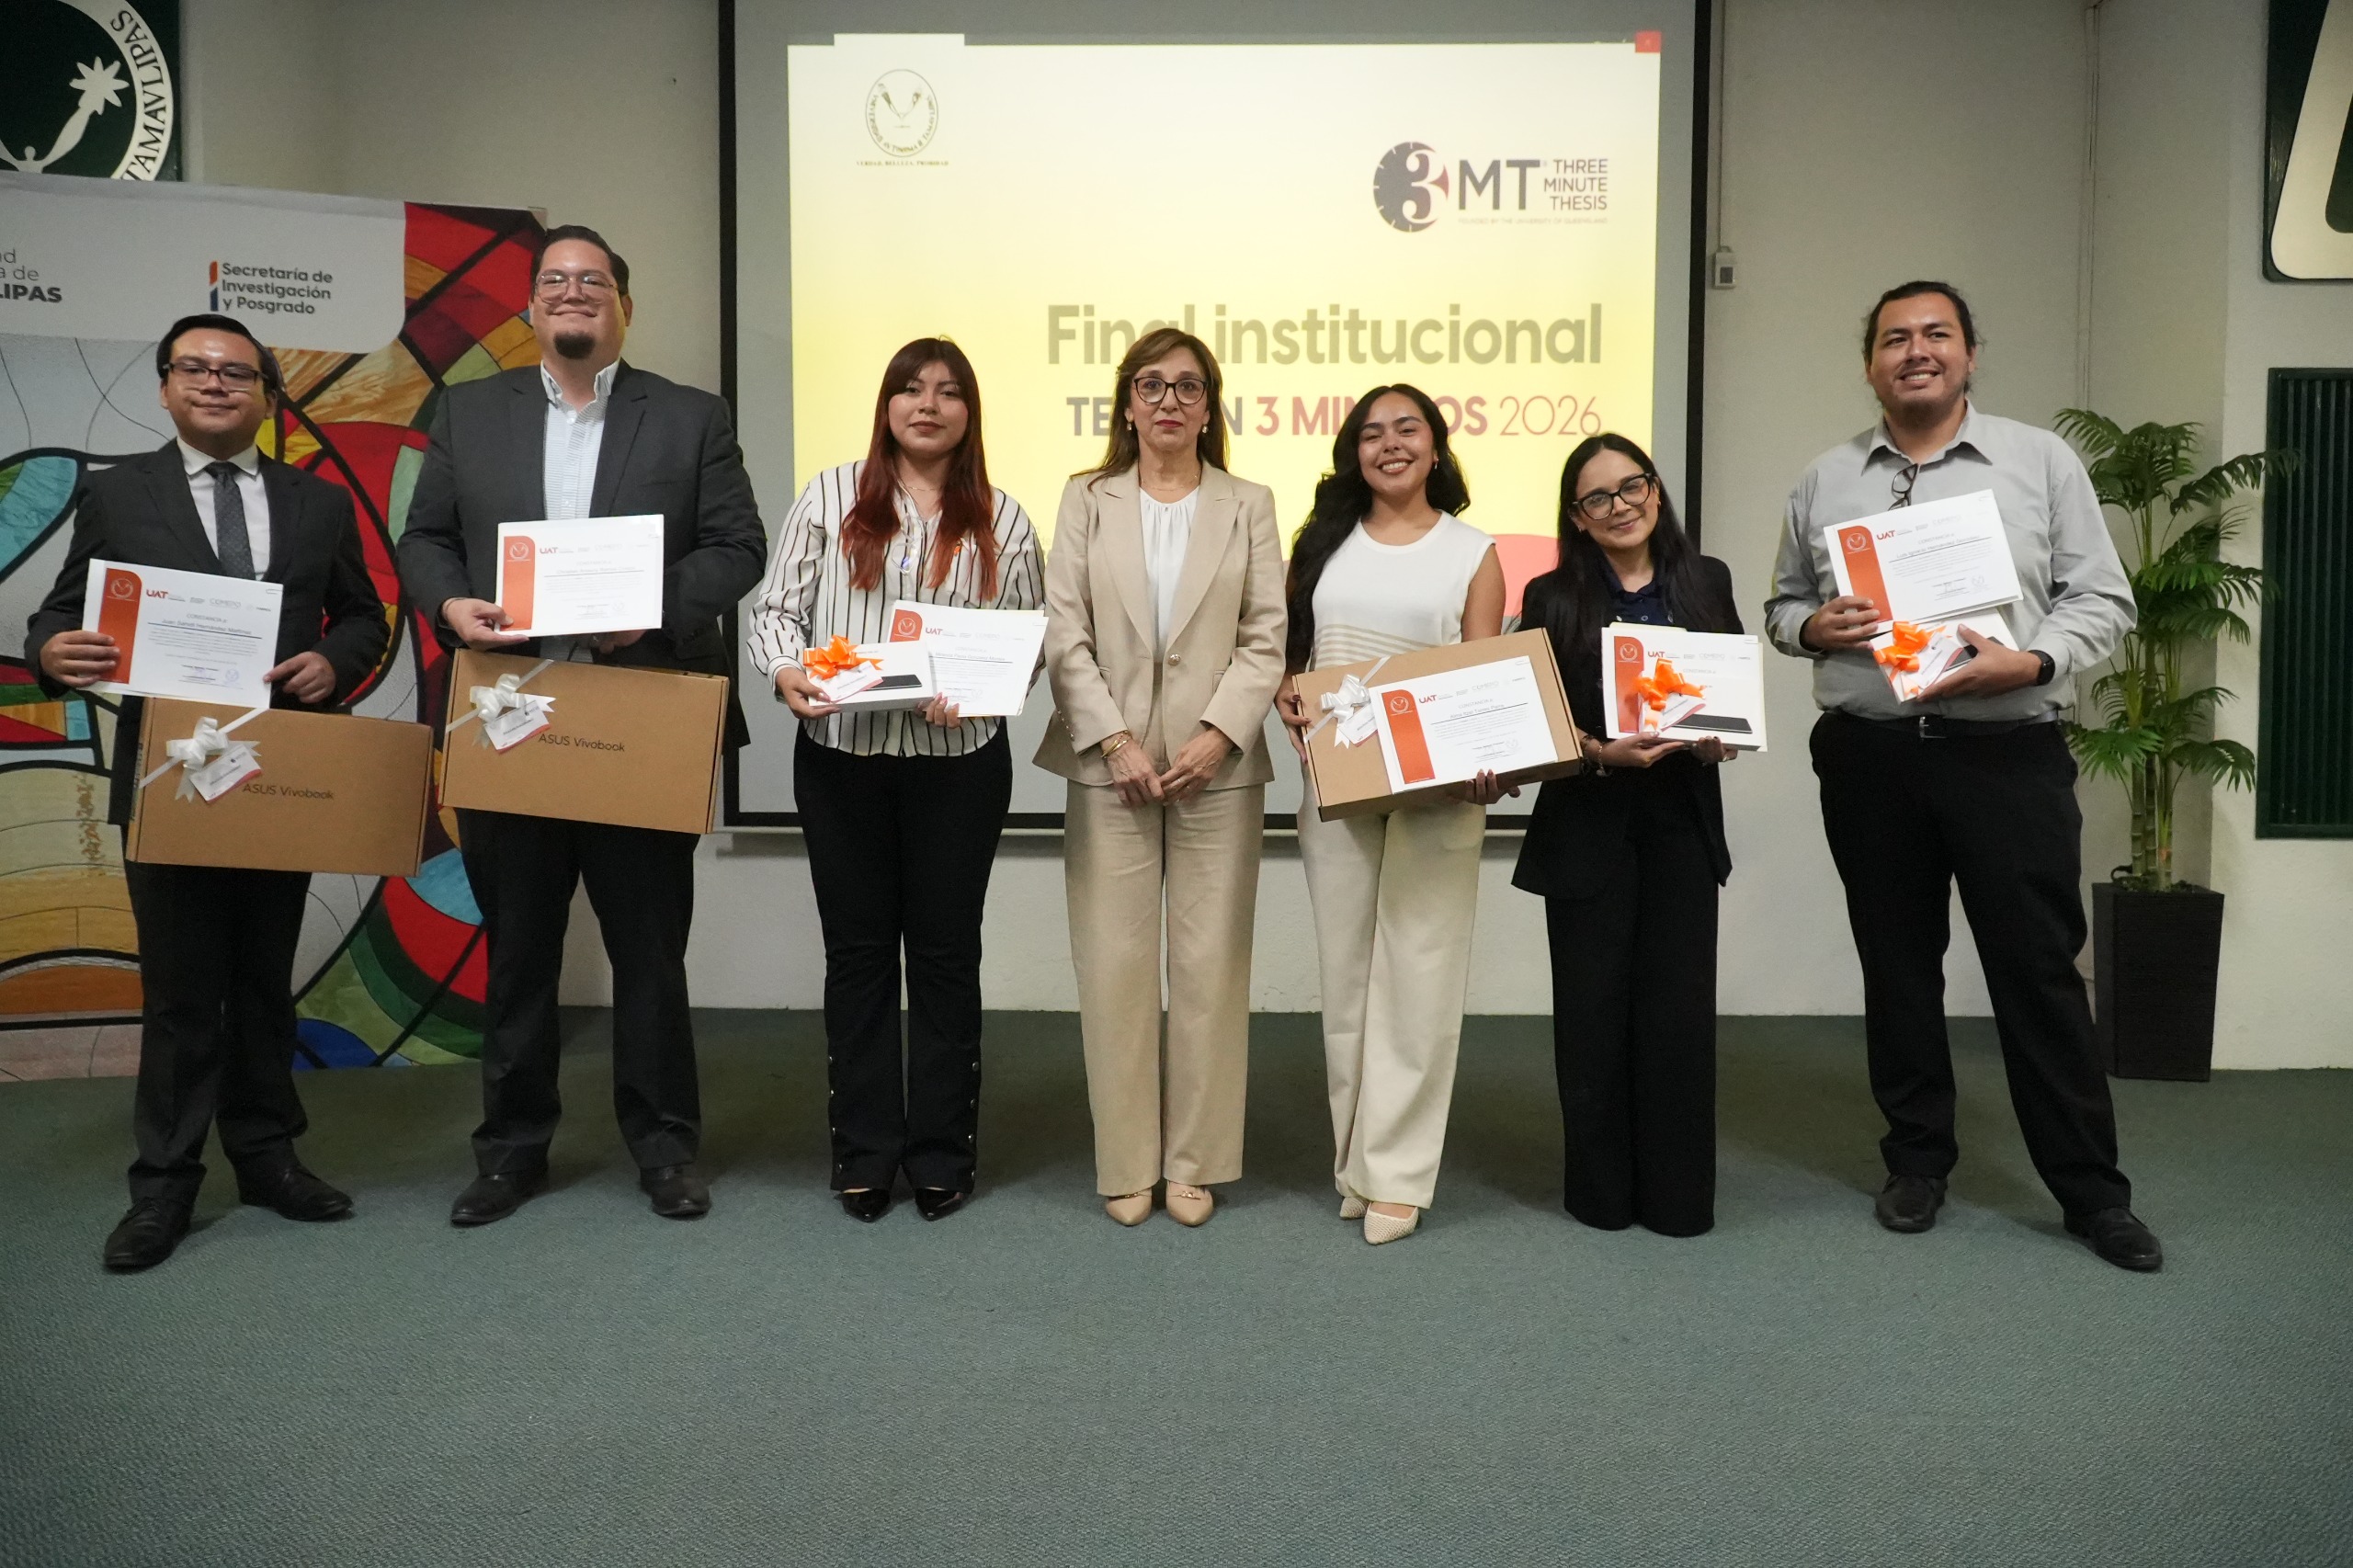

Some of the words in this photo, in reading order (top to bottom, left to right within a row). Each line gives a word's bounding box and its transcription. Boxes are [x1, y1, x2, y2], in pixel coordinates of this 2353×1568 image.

[1553, 158, 1608, 174] THREE
[1543, 177, 1608, 192] MINUTE
[1549, 195, 1608, 210] THESIS
[13, 265, 39, 281] de
[222, 262, 309, 282] Secretaría
[312, 270, 333, 284] de
[222, 278, 332, 301] Investigación
[222, 297, 233, 312] y
[236, 295, 315, 315] Posgrado
[1048, 304, 1196, 365] Fin
[1215, 303, 1602, 365] institucional
[1255, 395, 1280, 437] 3
[1499, 395, 1602, 437] 2026
[1876, 529, 1896, 540] UAT
[540, 546, 559, 554] UAT
[146, 589, 169, 599] UAT
[925, 627, 943, 636] UAT
[1418, 694, 1438, 704] UAT
[539, 733, 571, 746] ASUS
[574, 737, 625, 752] Vivobook
[243, 783, 277, 796] ASUS
[279, 786, 335, 801] Vivobook
